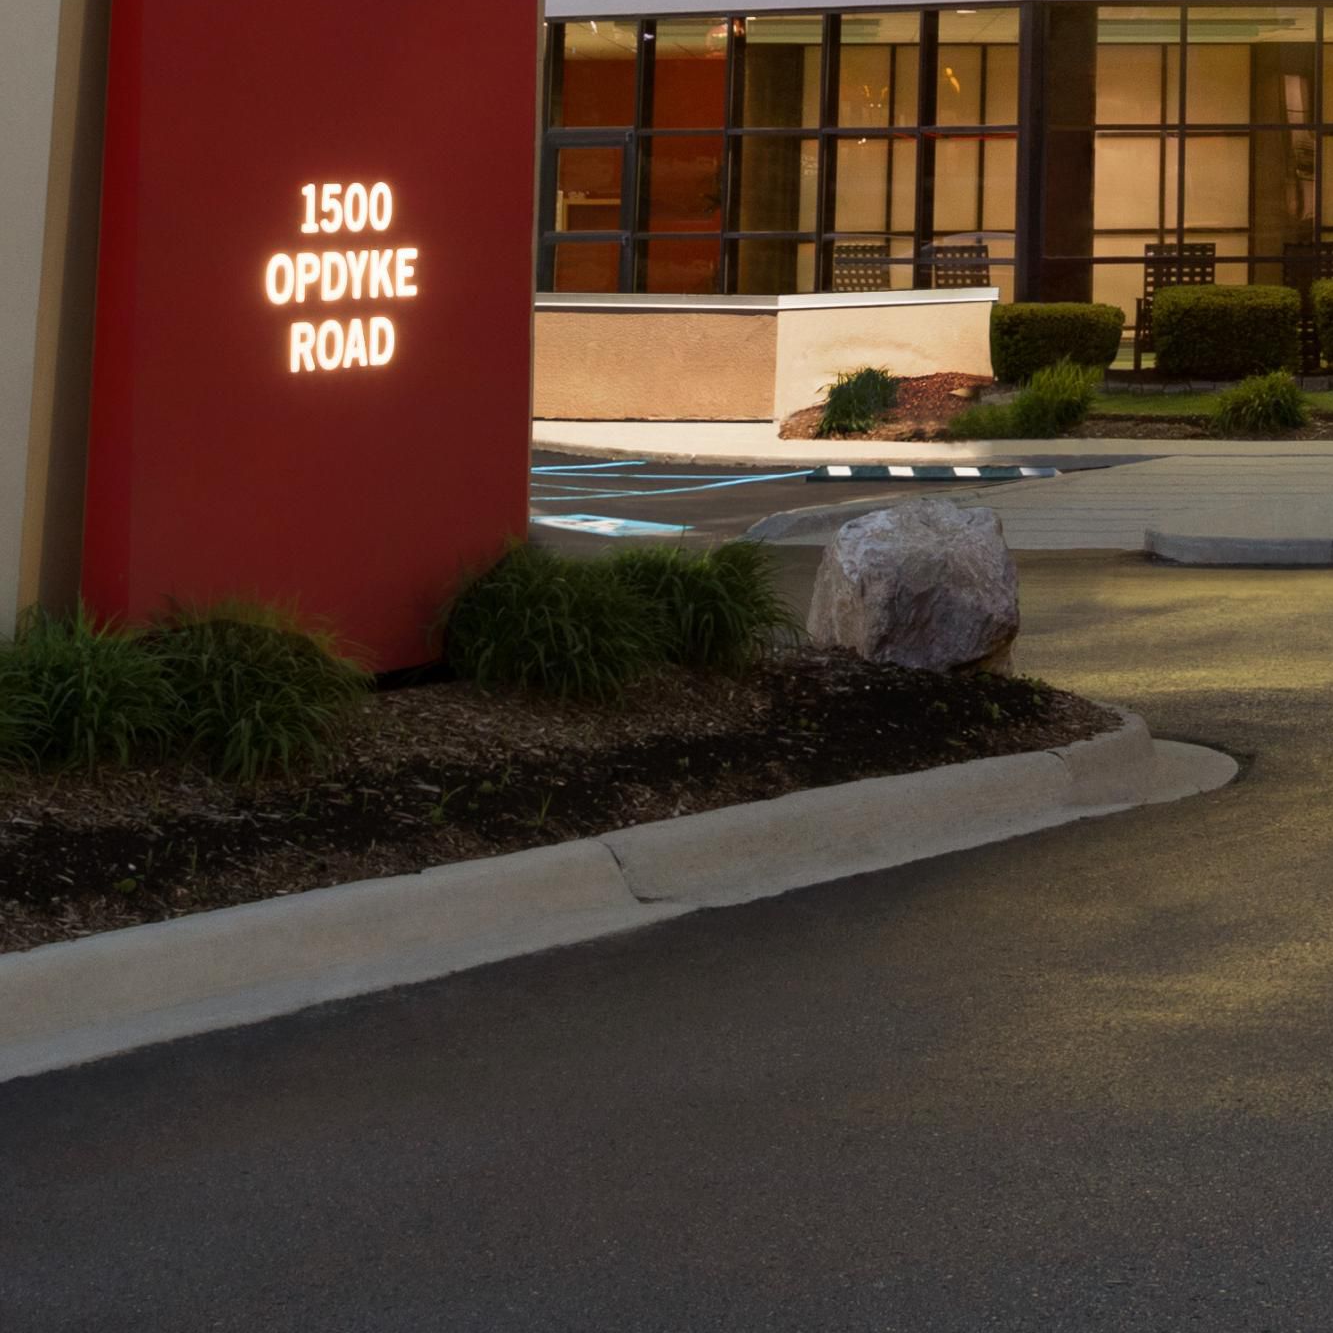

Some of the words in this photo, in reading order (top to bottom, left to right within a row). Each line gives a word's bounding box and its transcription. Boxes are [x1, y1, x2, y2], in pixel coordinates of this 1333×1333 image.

[300, 181, 394, 234] 1500
[264, 247, 419, 306] OPDYKE
[289, 316, 396, 373] ROAD
